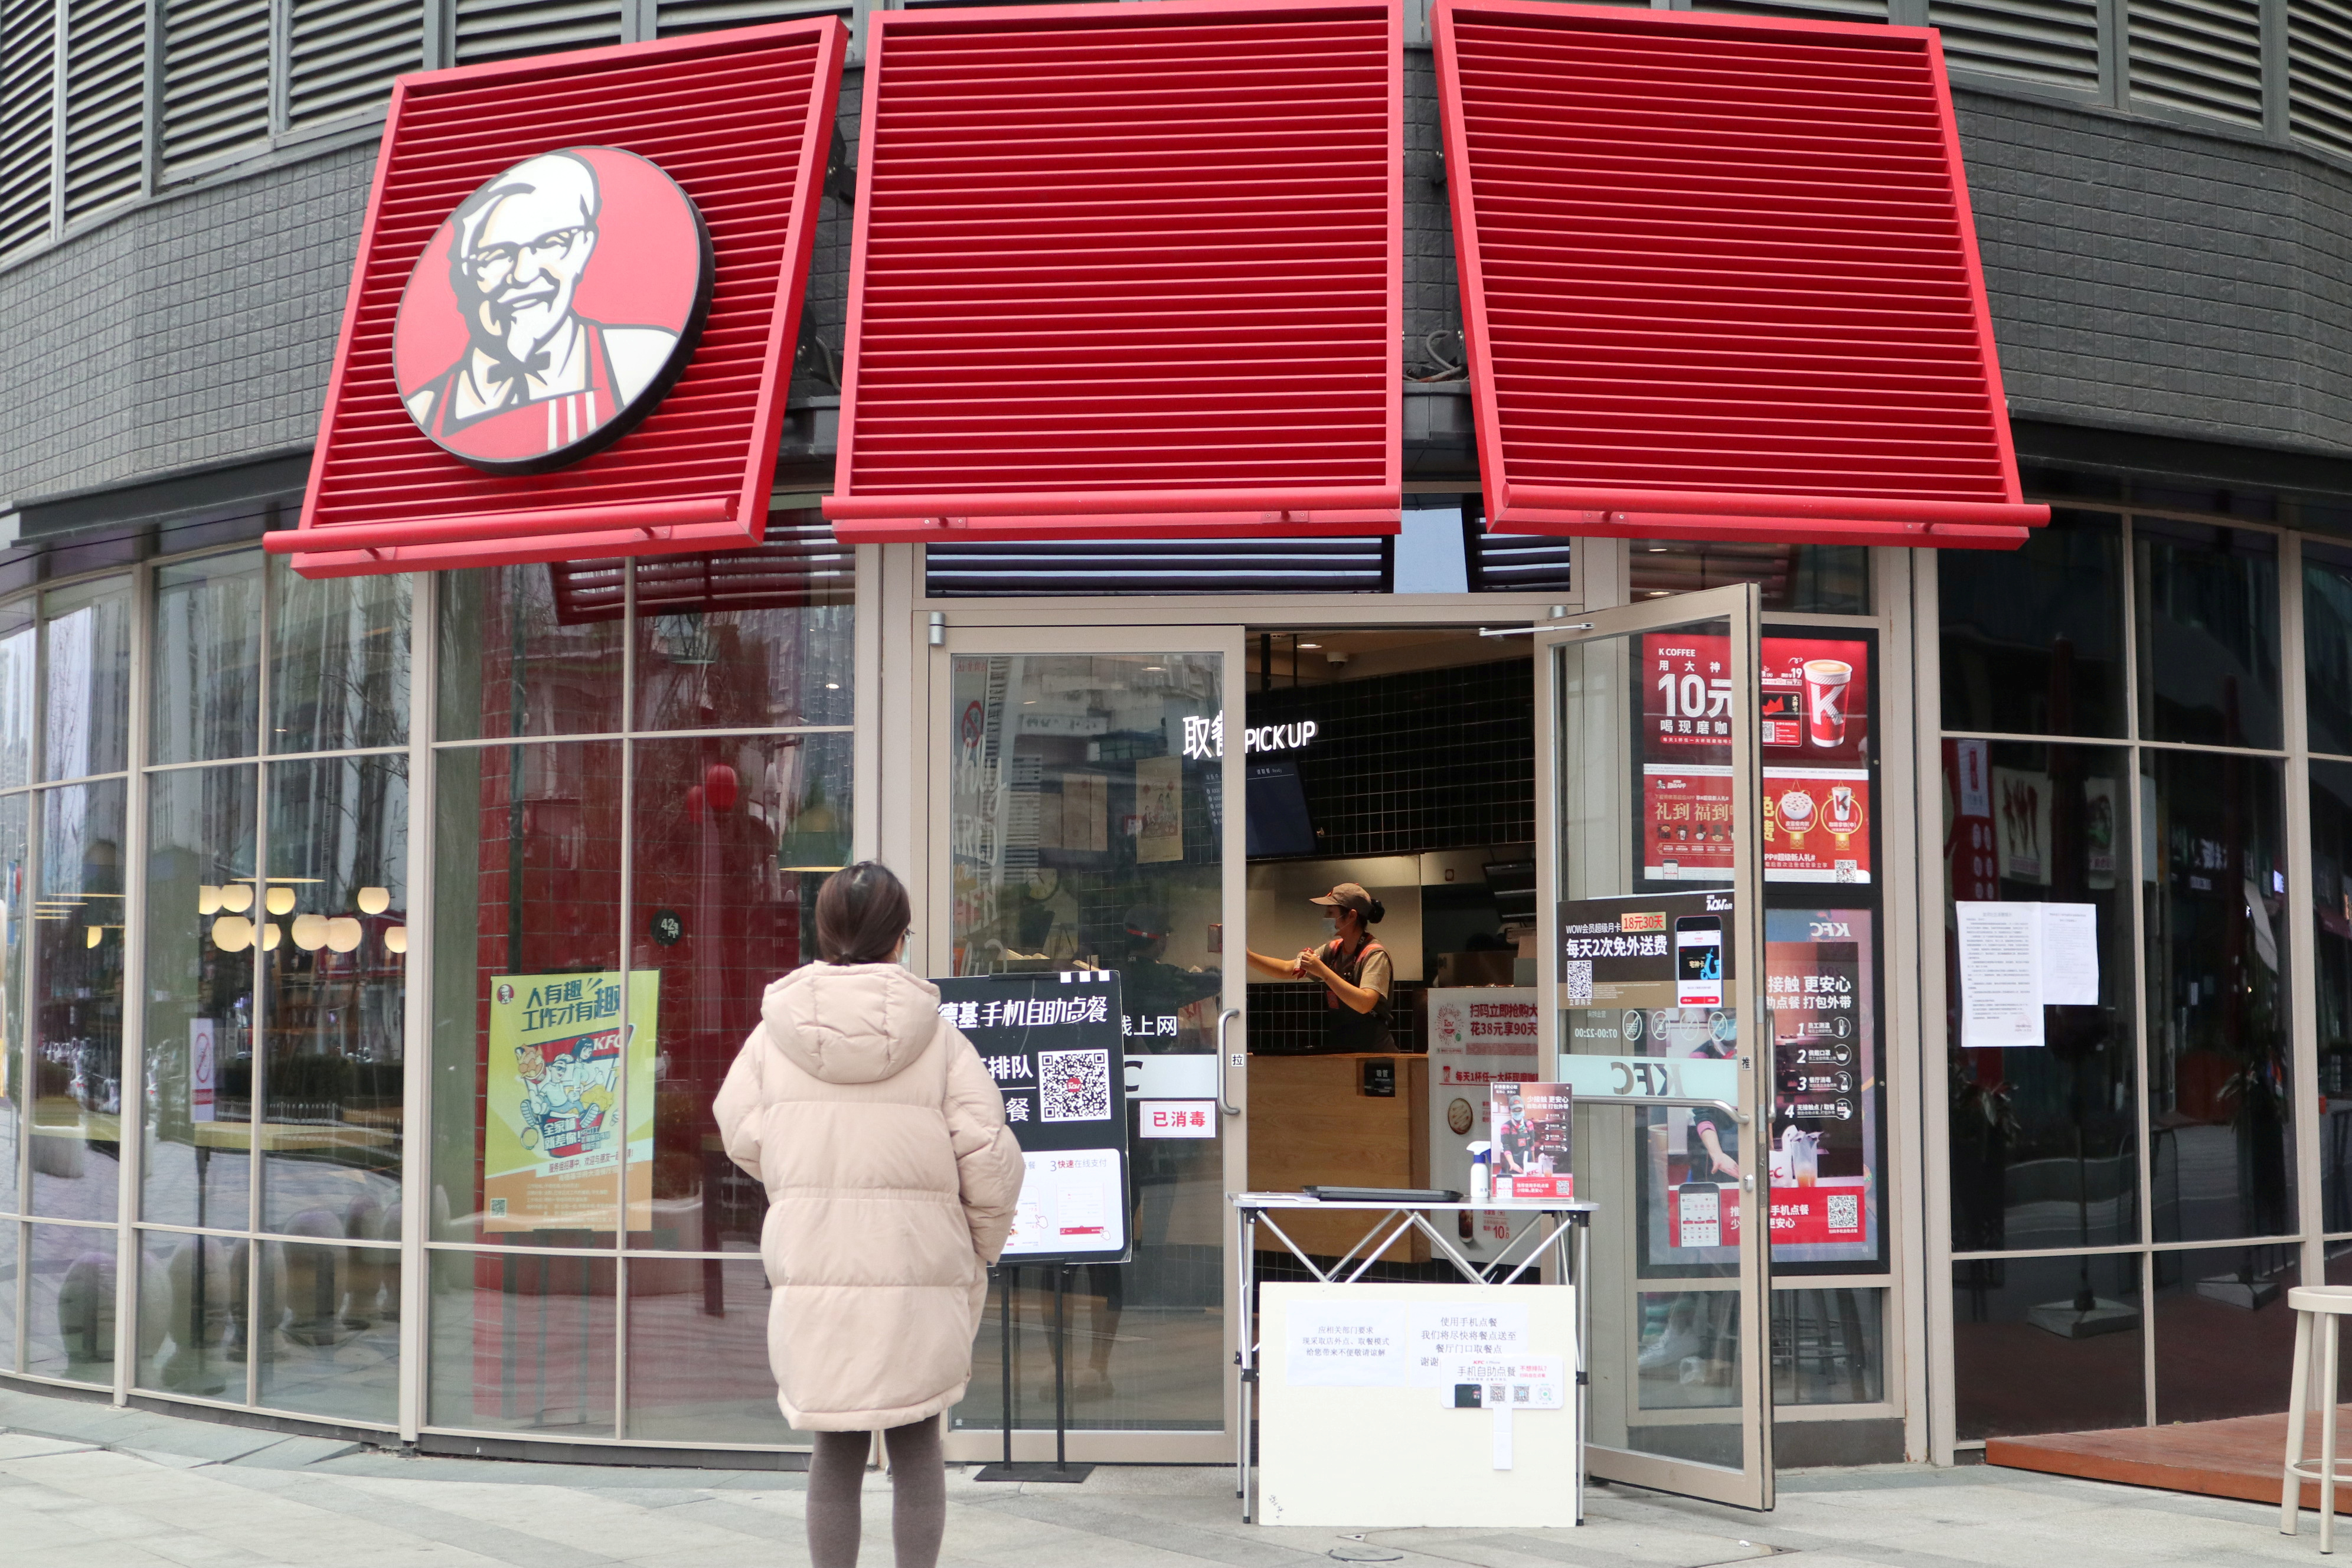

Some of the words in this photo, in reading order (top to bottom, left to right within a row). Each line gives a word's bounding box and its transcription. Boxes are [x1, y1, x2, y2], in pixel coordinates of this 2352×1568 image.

[1666, 648, 1696, 657] COFFEE
[1659, 660, 1720, 673] 用大神
[1660, 719, 1728, 735] 喝现磨咖
[1244, 721, 1316, 753] PICKUP
[1654, 802, 1690, 821] 礼到
[1566, 922, 1621, 934] WOW会员超级月卡
[1623, 915, 1664, 930] 18元30天
[1566, 935, 1668, 958] 每天2次免外送费
[1768, 975, 1800, 993] 接触
[1804, 975, 1852, 993] 更安心
[526, 979, 583, 1008] 人有趣
[521, 985, 621, 1031] 工作才有趣
[1803, 995, 1851, 1010] 打包外带
[980, 995, 1108, 1027] 手机自助点餐
[1470, 1021, 1538, 1036] 花38元享90天
[1796, 1023, 1805, 1036] 1
[1232, 1054, 1243, 1066] 拉
[1796, 1049, 1807, 1063] 2
[981, 1054, 1034, 1080] 排队
[1797, 1076, 1807, 1091] 3
[1005, 1097, 1030, 1122] 餐
[1785, 1104, 1795, 1118] 4
[1153, 1110, 1206, 1127] 已消毒
[1050, 1160, 1057, 1171] 3
[1057, 1158, 1107, 1169] 快速在线支付
[1770, 1204, 1809, 1216] 手机点餐
[1440, 1317, 1497, 1327] 使用手机点餐
[1318, 1326, 1374, 1334] 应相关部门要求
[1421, 1330, 1516, 1341] 我们将尽快将餐点送至
[1302, 1337, 1390, 1346] 现采取店外点、取餐模式
[1306, 1348, 1386, 1357] 给您带来不便敬请谅解
[1436, 1344, 1502, 1354] 餐厅门口取餐点
[1421, 1357, 1439, 1367] 谢谢
[1457, 1366, 1516, 1377] 手机自助点餐
